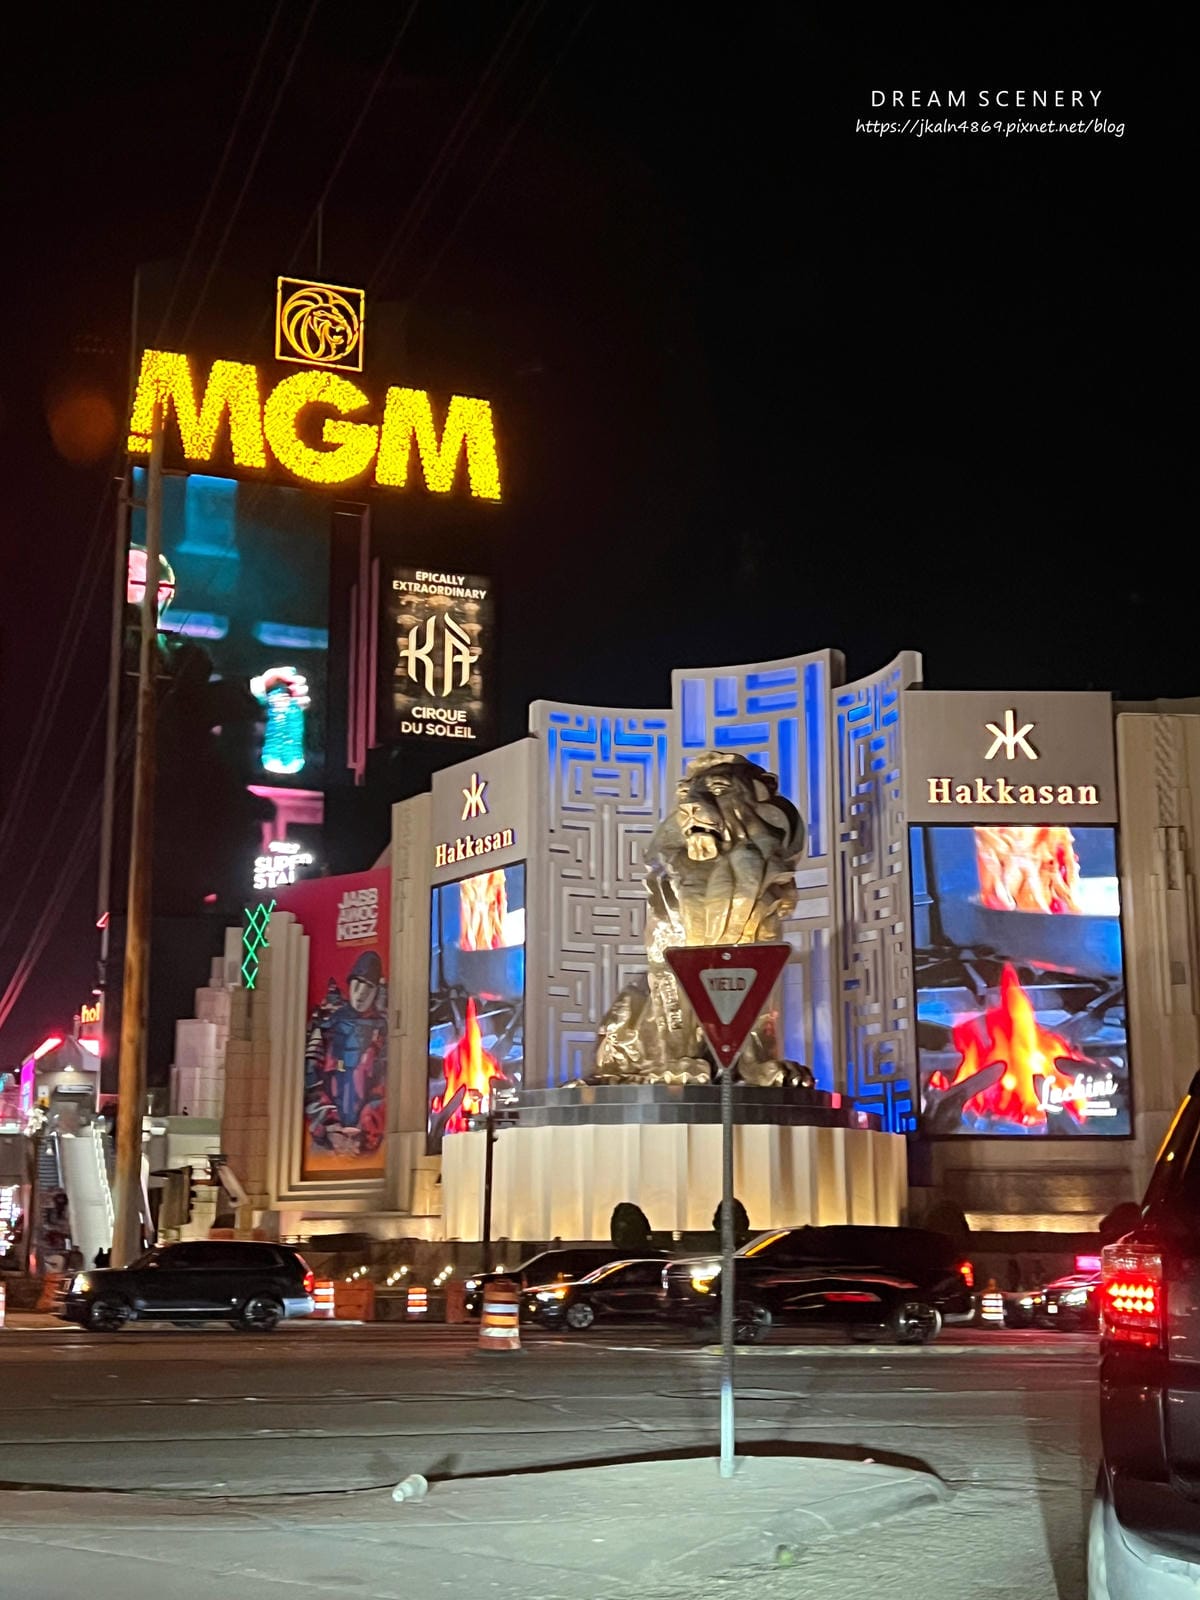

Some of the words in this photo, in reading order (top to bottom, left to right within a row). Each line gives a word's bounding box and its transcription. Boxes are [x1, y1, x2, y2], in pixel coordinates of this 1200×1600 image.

[127, 349, 502, 499] MGM
[415, 571, 465, 586] EPICALLY
[392, 580, 487, 600] EXTRAORDINARY
[411, 706, 467, 725] CIRQUE
[401, 721, 423, 734] DU
[425, 723, 476, 739] SOLEIL
[927, 777, 1099, 805] Hakkasan
[435, 829, 514, 868] Hakkasan
[708, 977, 747, 991] YIELD
